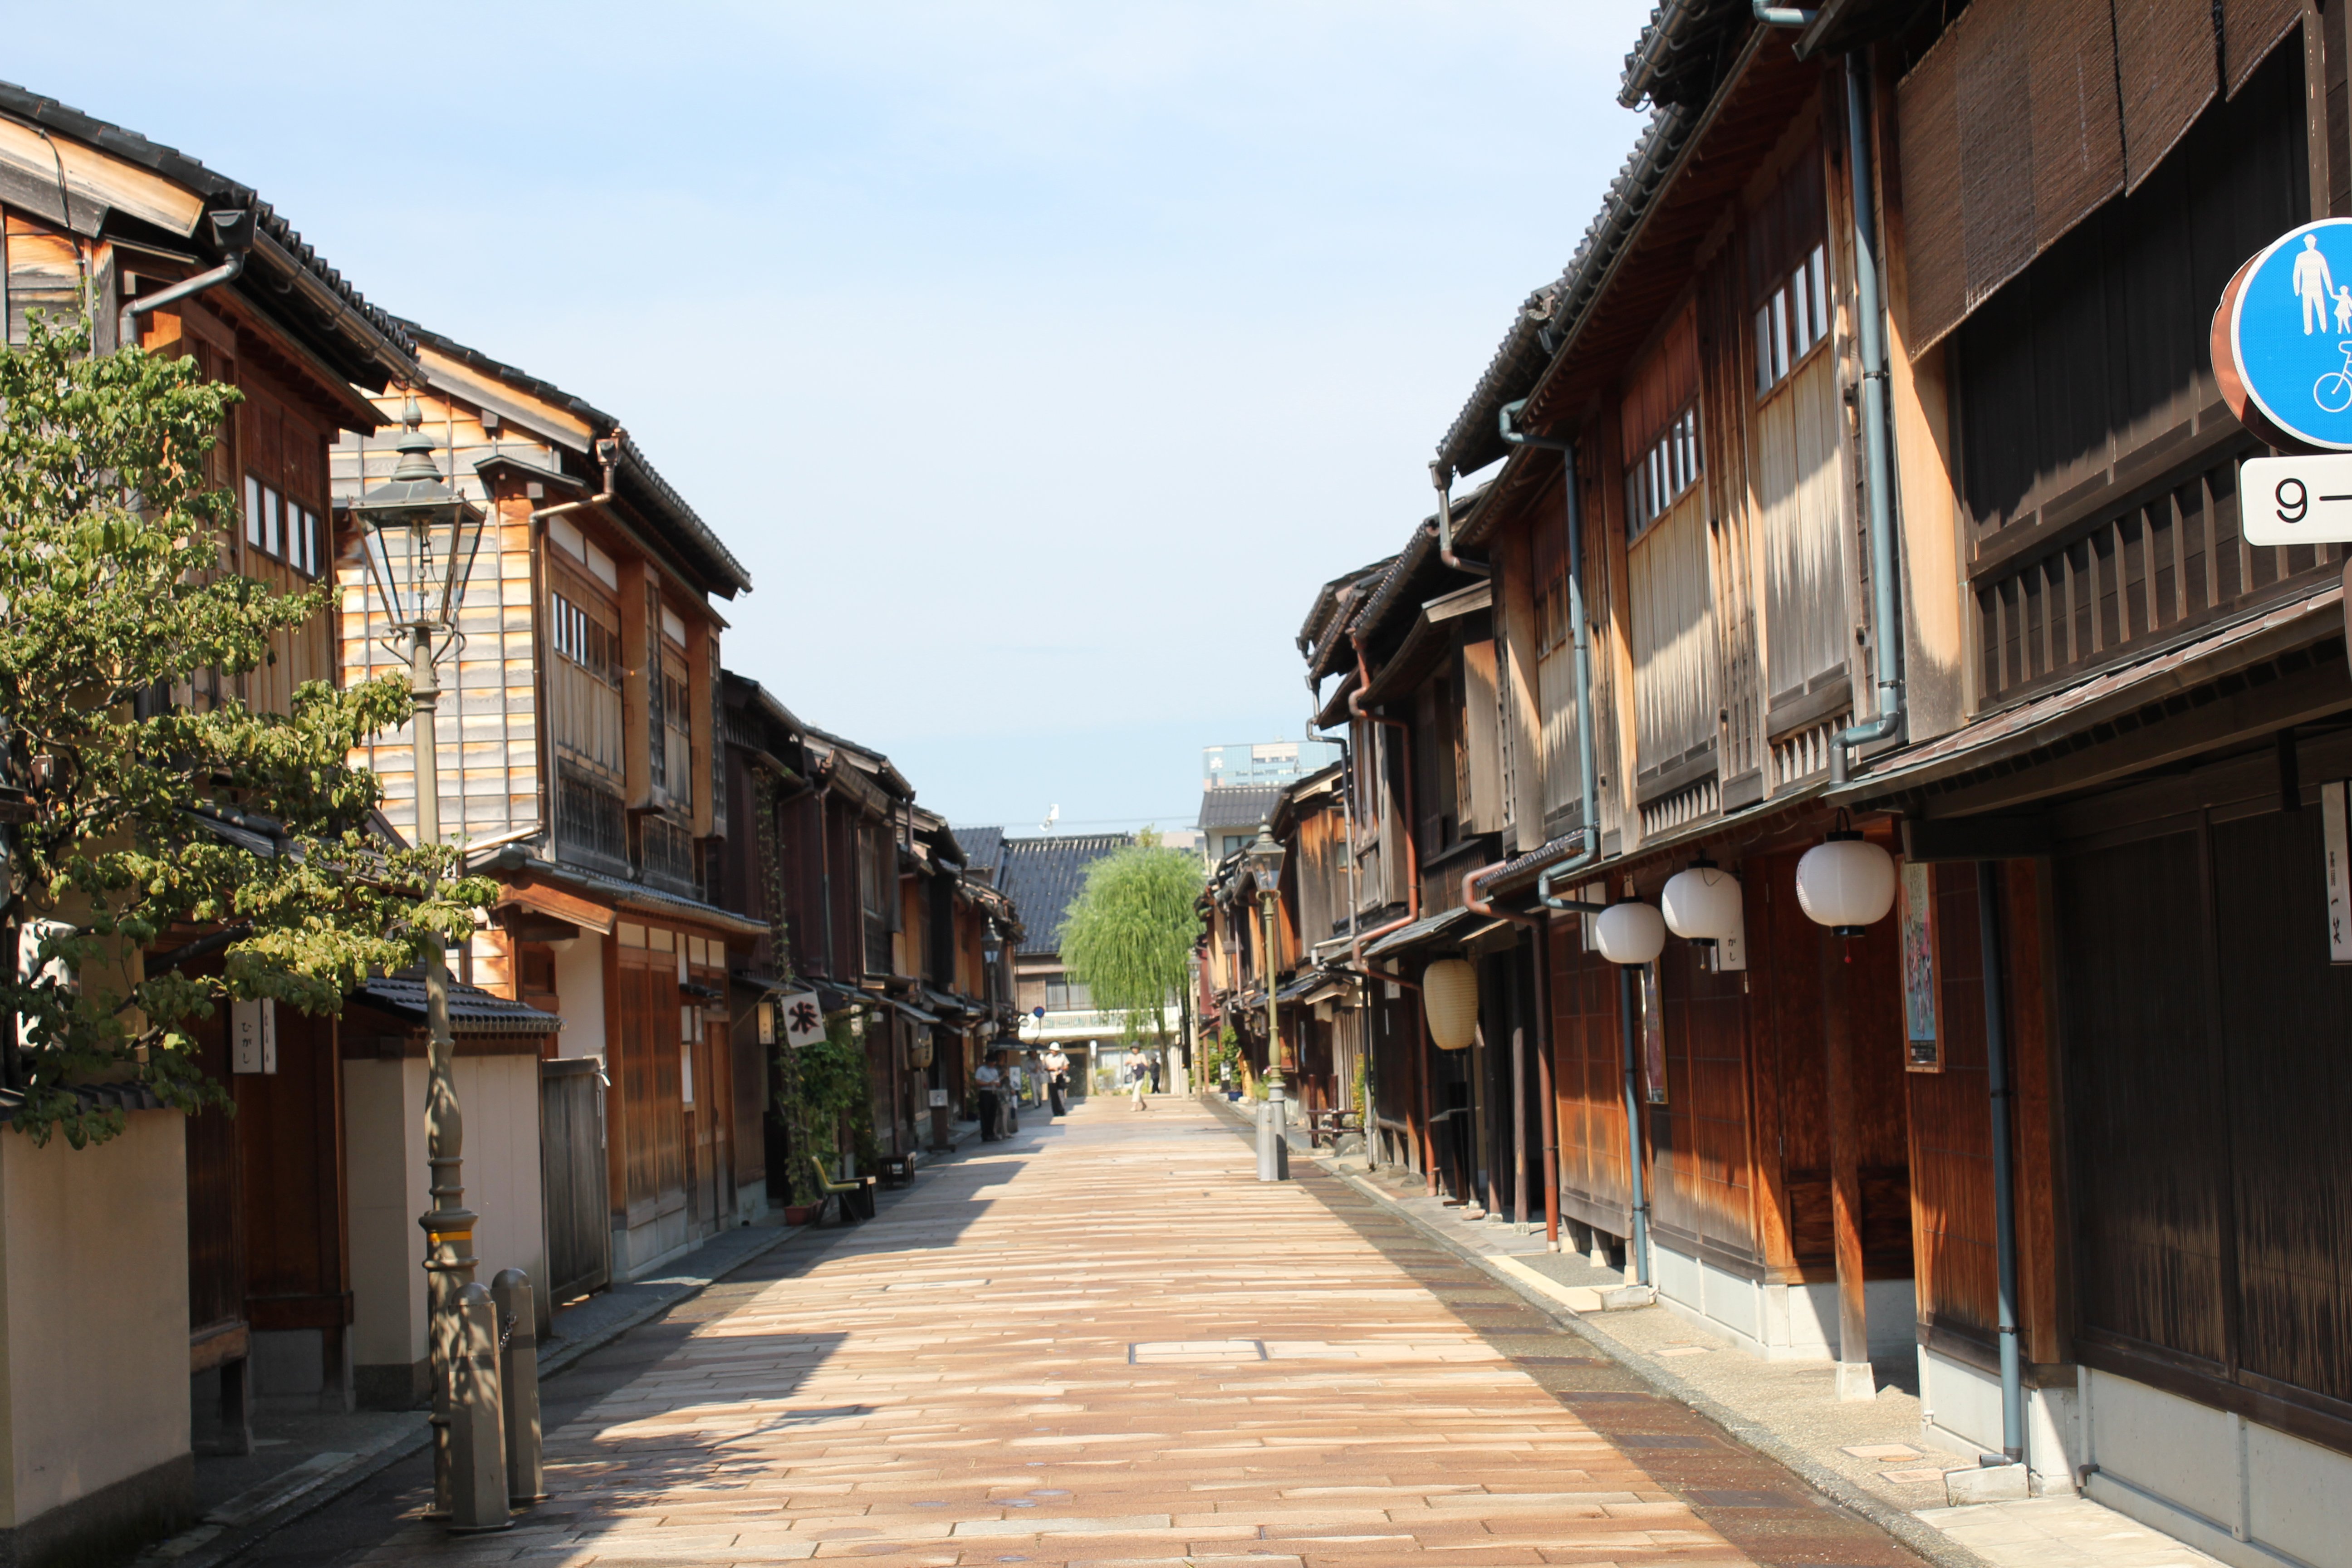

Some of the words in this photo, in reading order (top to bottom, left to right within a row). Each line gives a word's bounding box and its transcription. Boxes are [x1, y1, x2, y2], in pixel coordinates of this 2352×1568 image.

[1728, 930, 1737, 962] がし
[241, 1022, 252, 1064] ひがし
